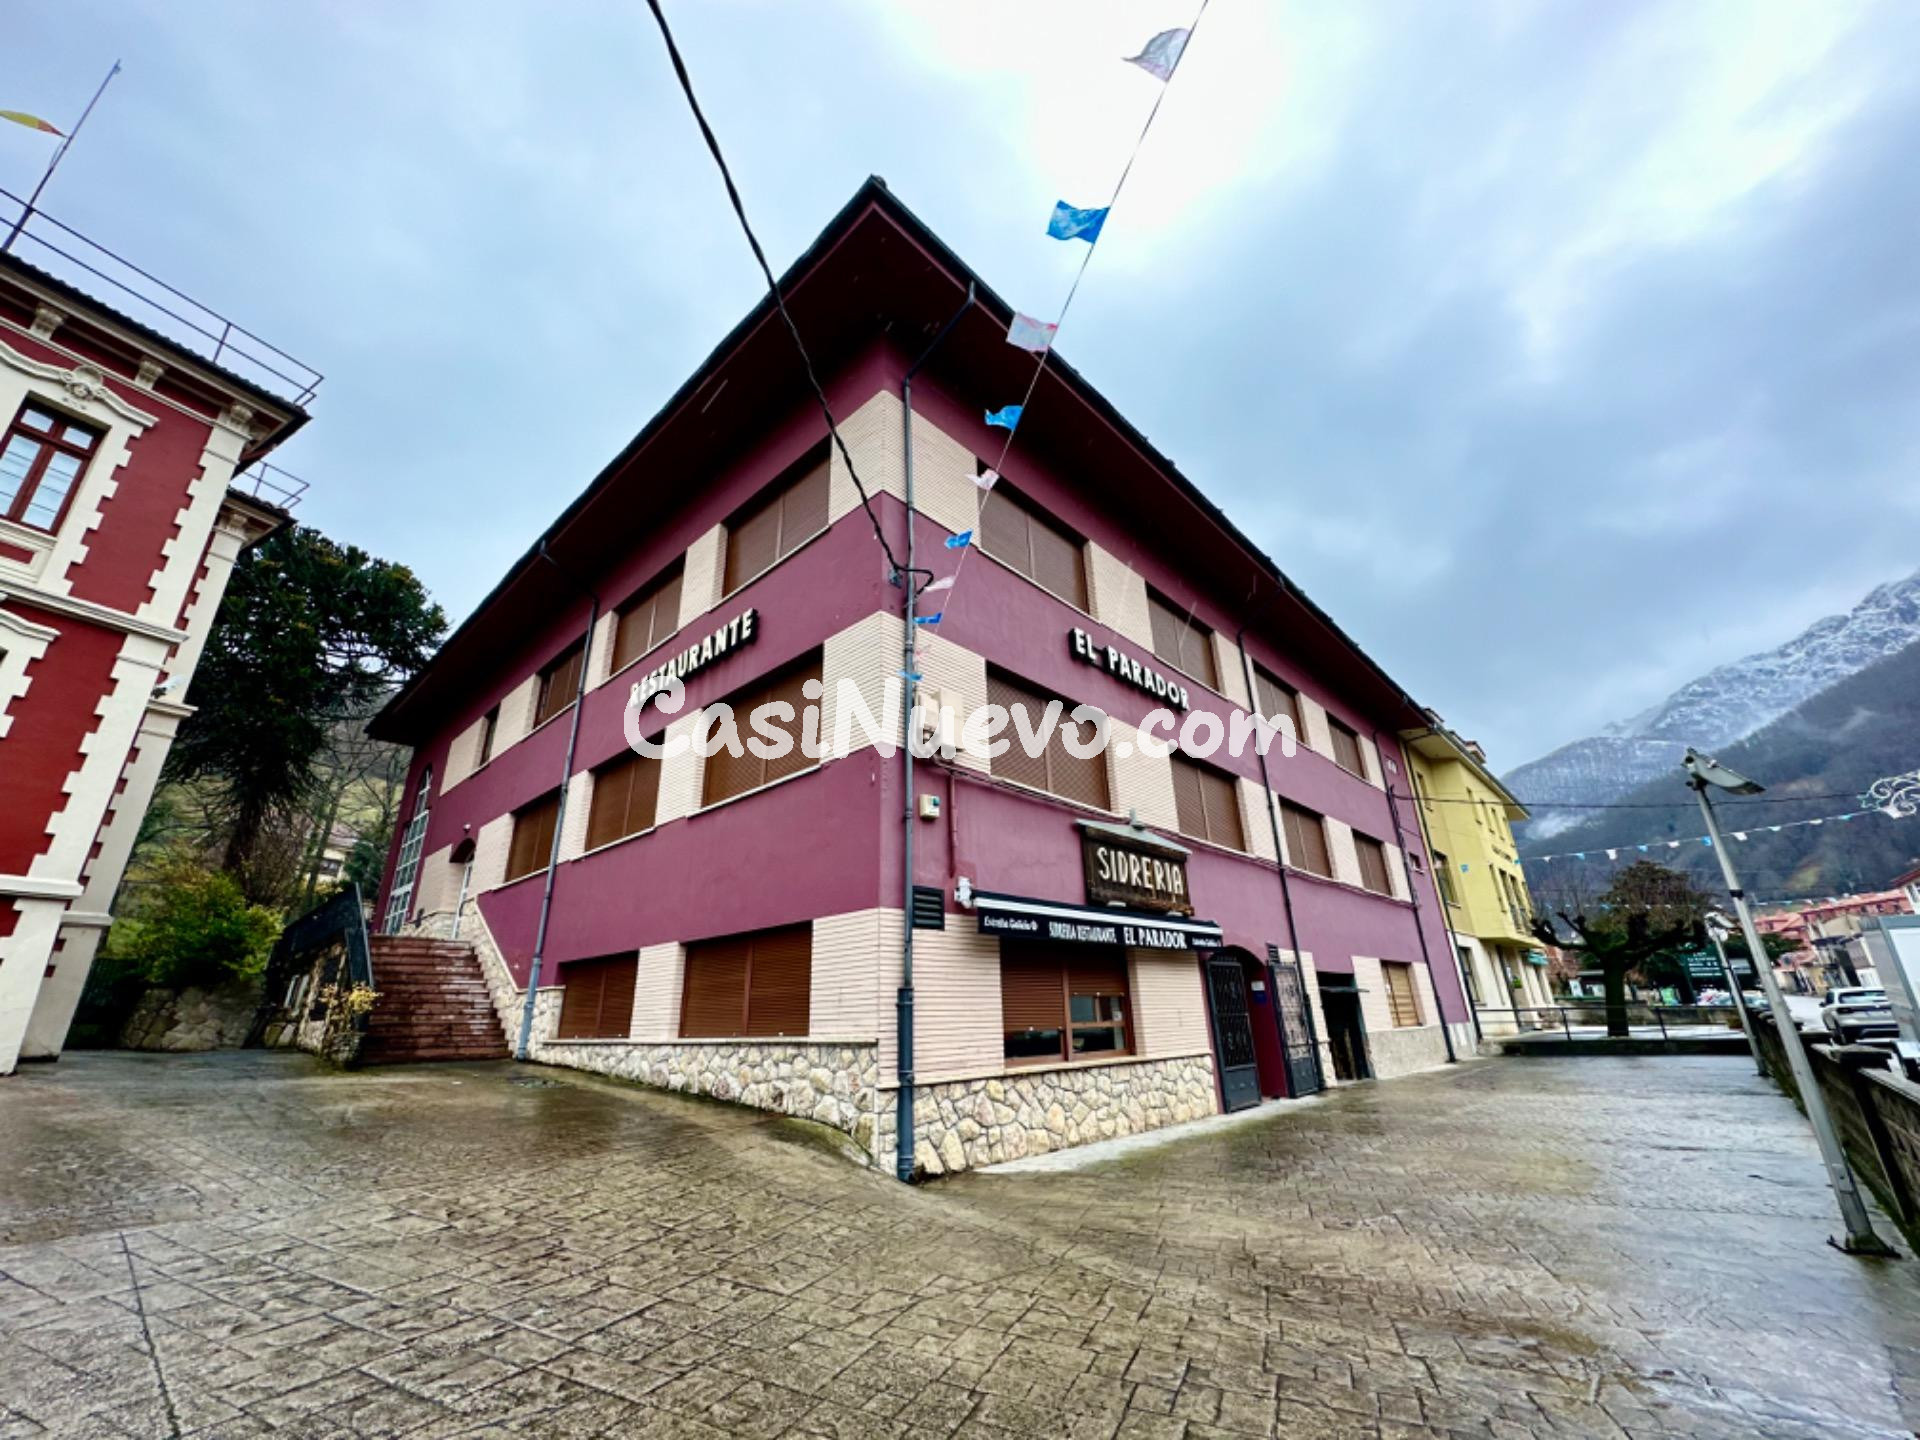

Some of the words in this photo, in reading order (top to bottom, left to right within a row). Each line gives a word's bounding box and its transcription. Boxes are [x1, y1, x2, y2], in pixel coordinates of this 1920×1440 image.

[630, 604, 755, 708] RESTAURANTE
[1073, 626, 1097, 661] EL
[1107, 644, 1190, 711] PARADOR
[1096, 846, 1184, 896] SIDRERIA
[1123, 926, 1137, 945] EL
[1138, 928, 1188, 950] PARADOR
